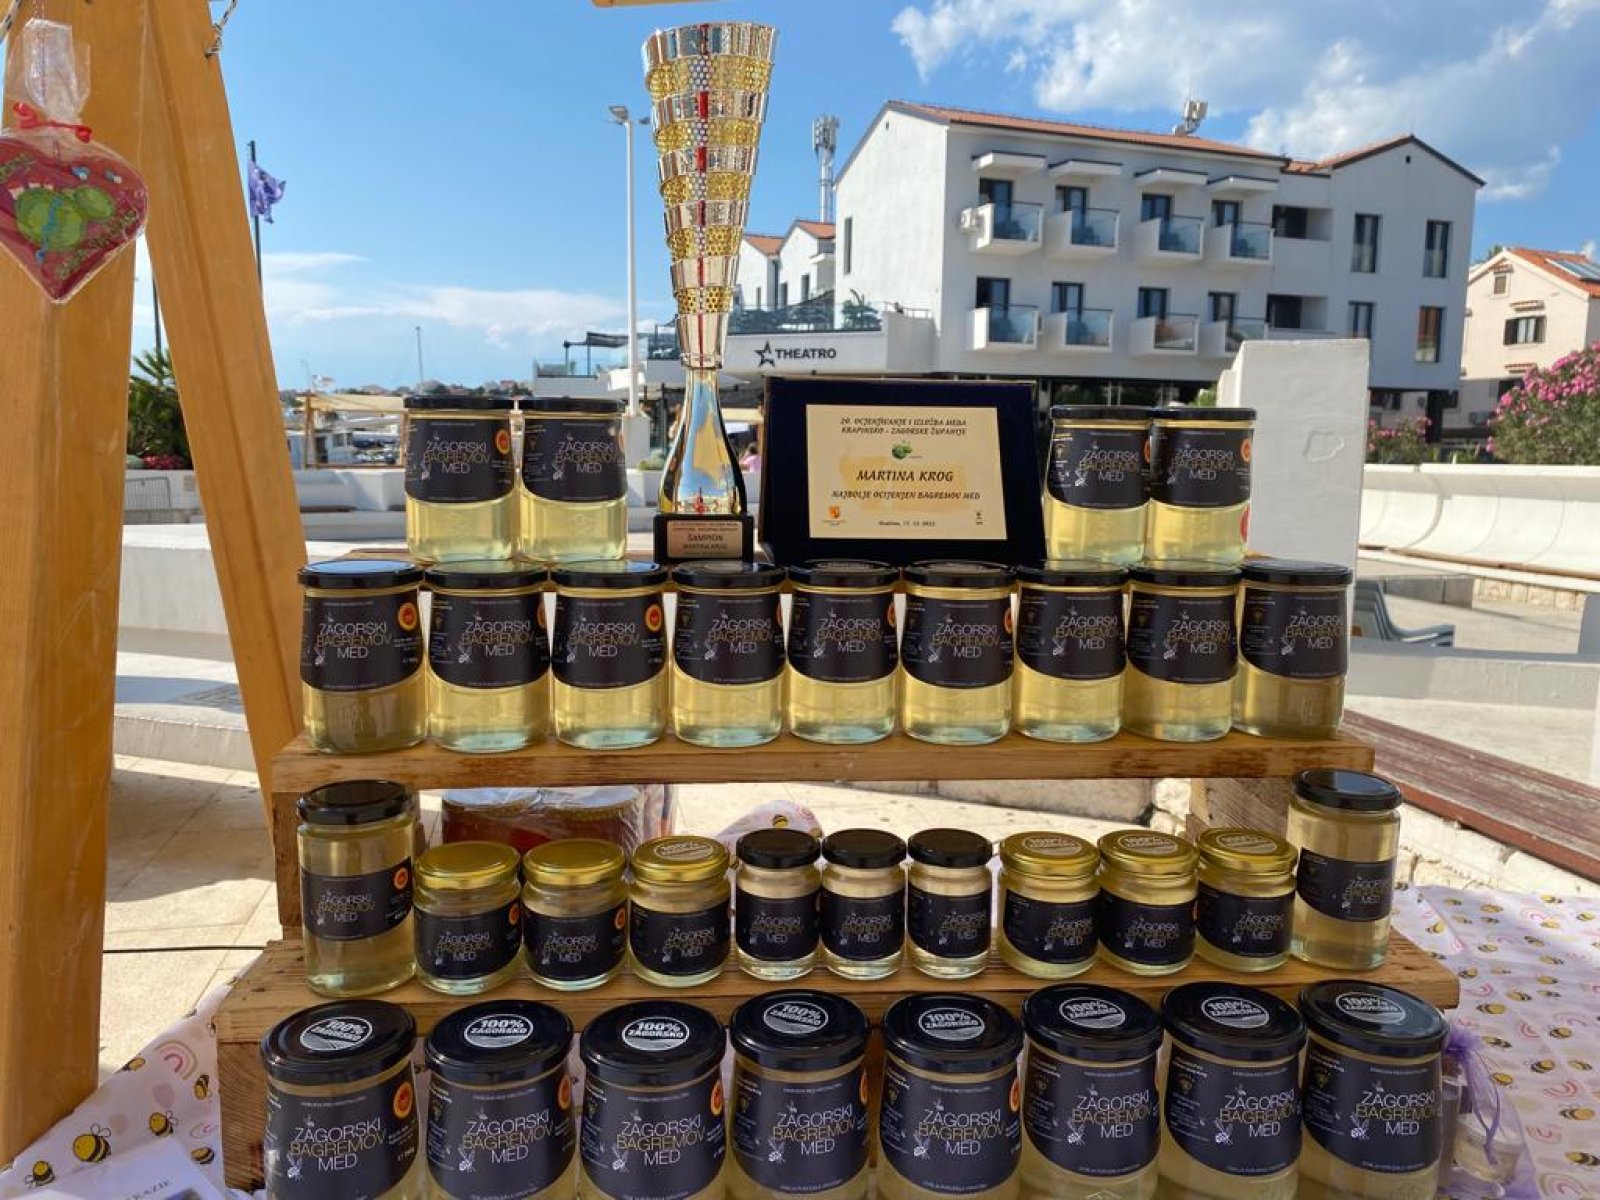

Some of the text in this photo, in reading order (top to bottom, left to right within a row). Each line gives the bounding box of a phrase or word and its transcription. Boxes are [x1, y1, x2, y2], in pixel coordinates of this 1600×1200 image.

[775, 348, 837, 359] THEATRO
[441, 462, 471, 473] MED
[576, 462, 602, 473] MED
[856, 470, 953, 482] MARTINA KROG
[1099, 471, 1124, 482] MED
[1189, 469, 1217, 481] MED
[963, 491, 981, 500] MED
[319, 621, 388, 634] ZAGORSKI
[465, 620, 531, 634] ZAGORSKI
[573, 622, 636, 635] ZAGORSKI
[711, 618, 772, 631] ZAGORSKI
[819, 618, 881, 631] ZAGORSKI
[936, 623, 998, 636] ZAGORSKI
[730, 642, 757, 654] MED
[838, 641, 866, 653] MED
[1079, 638, 1106, 650] MED
[1190, 642, 1217, 654] MED
[1308, 637, 1333, 650] MED
[337, 646, 369, 659] MED
[484, 644, 515, 657] MED
[588, 645, 618, 658] MED
[953, 646, 982, 659] MED
[334, 912, 358, 922] MED
[767, 934, 788, 943] MED
[857, 932, 878, 943] MED
[957, 930, 976, 940] MED
[1063, 936, 1083, 947] MED
[1253, 930, 1273, 940] MED
[1144, 938, 1167, 948] MED
[452, 951, 476, 961] MED
[559, 952, 582, 963] MED
[681, 947, 703, 957] MED
[781, 1004, 822, 1020] 100%
[926, 1012, 971, 1022] 100%
[480, 1019, 525, 1029] 100%
[636, 1021, 681, 1031] 100%
[627, 1030, 684, 1038] ZAGORSKO
[1076, 1089, 1149, 1111] ZAGORSKI
[1224, 1088, 1294, 1110] ZAGORSKI
[1362, 1090, 1434, 1109] ZAGORSKI
[466, 1108, 550, 1136] ZAGORSKI
[777, 1104, 853, 1128] ZAGORSKI
[923, 1108, 1001, 1127] ZAGORSKI
[294, 1117, 381, 1143] ZAGORSKI
[621, 1114, 701, 1137] ZAGORSKI
[773, 1119, 856, 1143] BAGREMOV
[918, 1122, 1003, 1141] BAGREMOV
[1100, 1123, 1134, 1139] MED
[1249, 1121, 1281, 1137] MED
[1385, 1121, 1420, 1136] MED
[289, 1129, 386, 1157] BAGREMOV
[462, 1124, 554, 1150] BAGREMOV
[616, 1128, 706, 1151] BAGREMOV
[801, 1138, 836, 1156] MED
[945, 1139, 981, 1156] MED
[491, 1145, 528, 1163] MED
[644, 1150, 681, 1166] MED
[318, 1154, 357, 1172] MED
